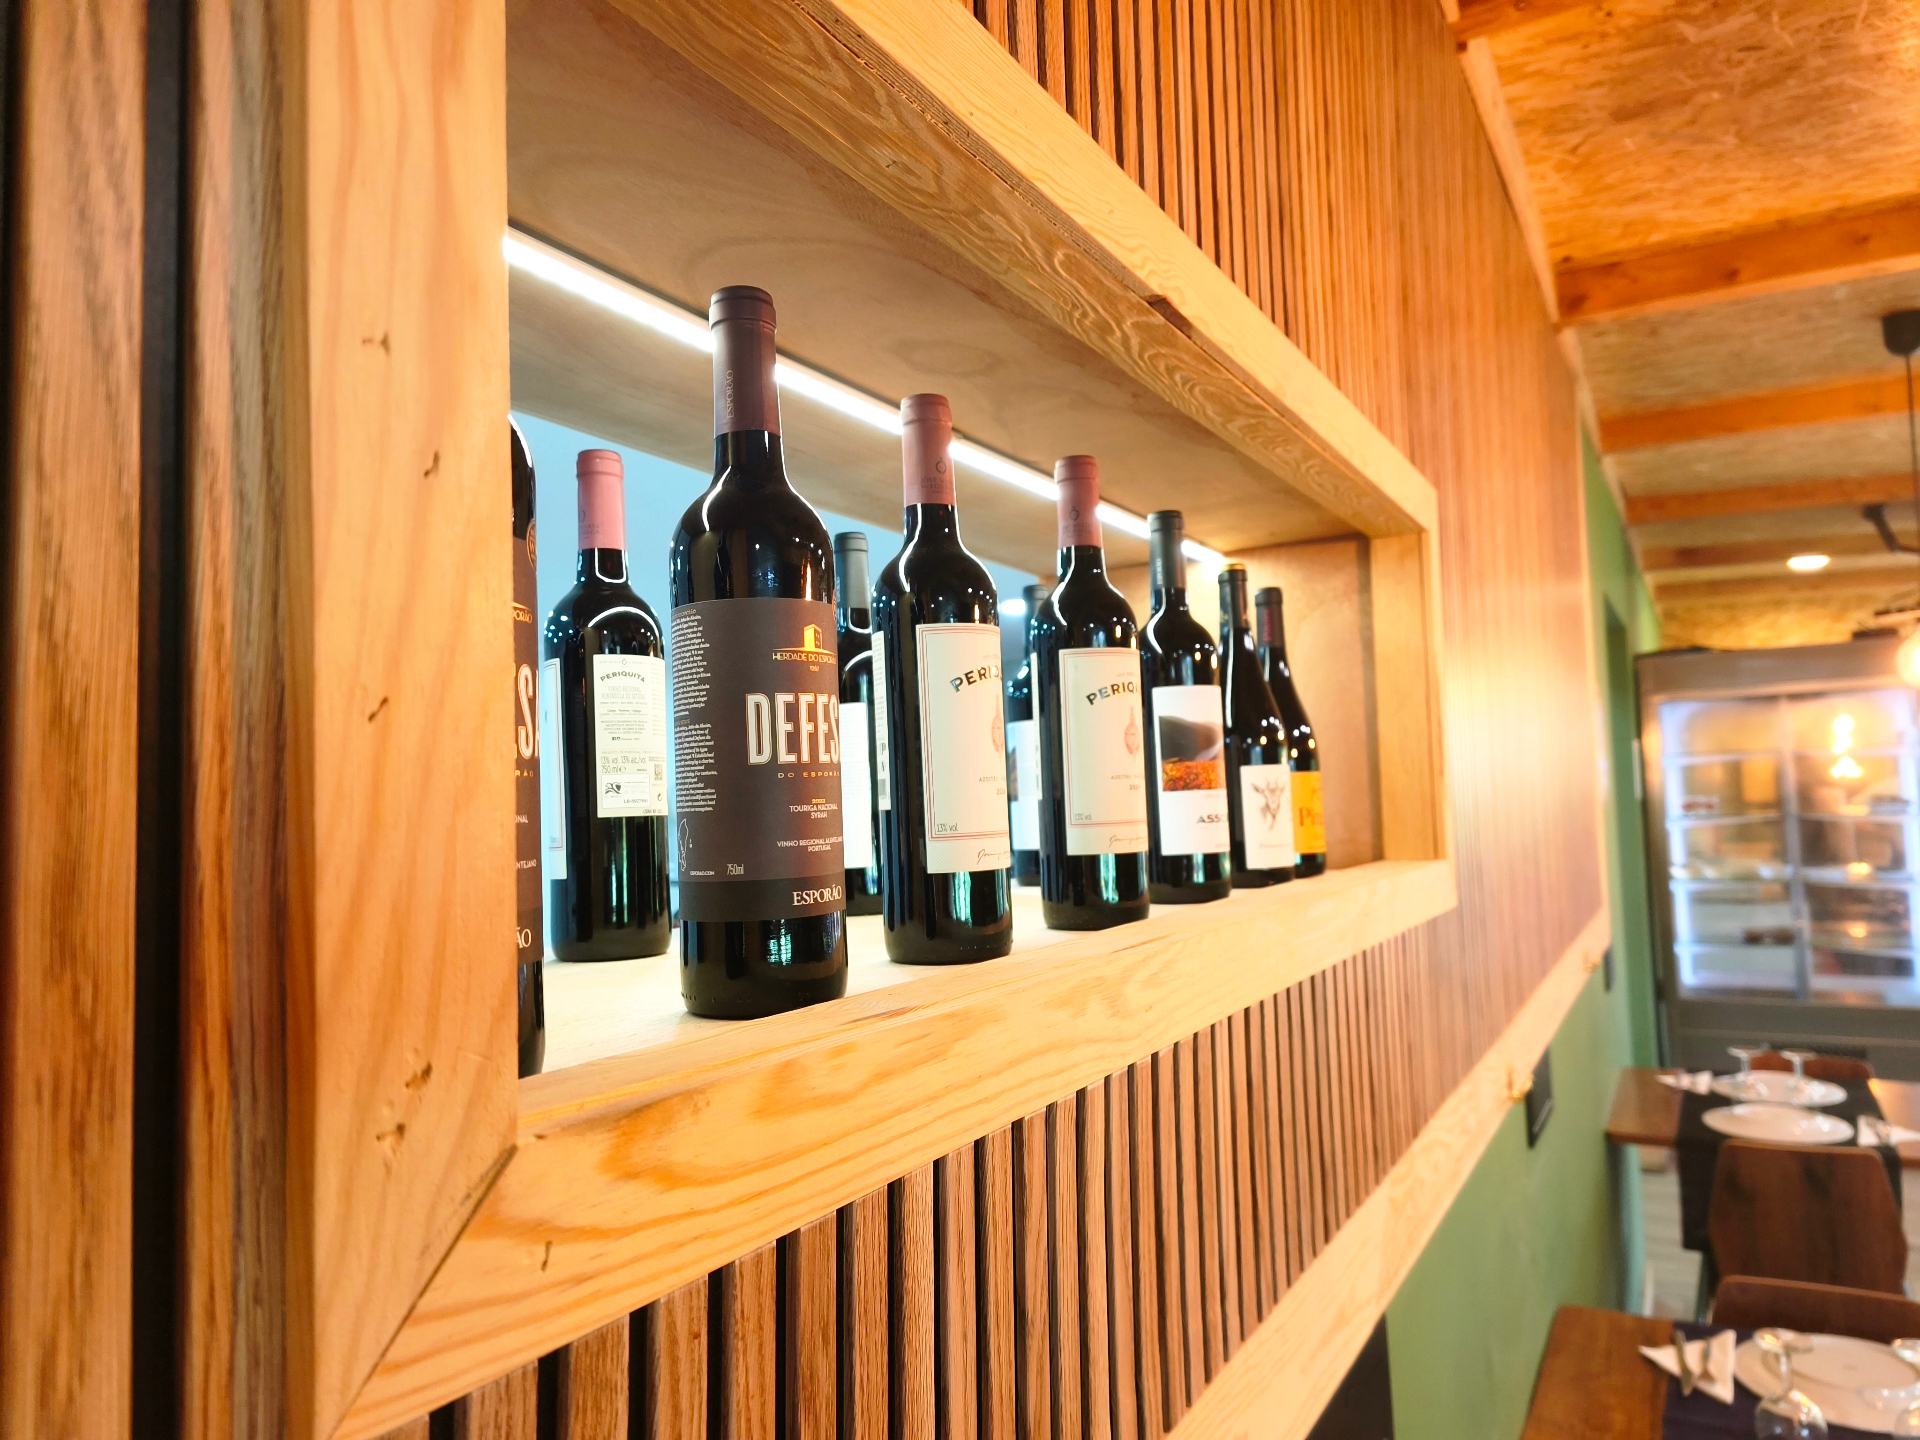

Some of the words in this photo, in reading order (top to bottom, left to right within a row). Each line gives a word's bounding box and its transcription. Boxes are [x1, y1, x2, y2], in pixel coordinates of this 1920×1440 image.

[725, 369, 735, 419] ESPORÃO
[773, 652, 807, 662] HERDADE
[808, 653, 819, 662] DO
[600, 670, 645, 683] PERIQUITA
[789, 804, 817, 813] TOURIGA
[817, 803, 838, 811] NACIONAL
[810, 811, 828, 819] SYRAH
[936, 823, 948, 833] 13%
[777, 840, 798, 848] VINHO
[799, 838, 826, 846] REGIONAL
[808, 844, 832, 852] PORTUGAL
[726, 863, 745, 876] 750ml
[792, 883, 842, 906] ESPORÃO
